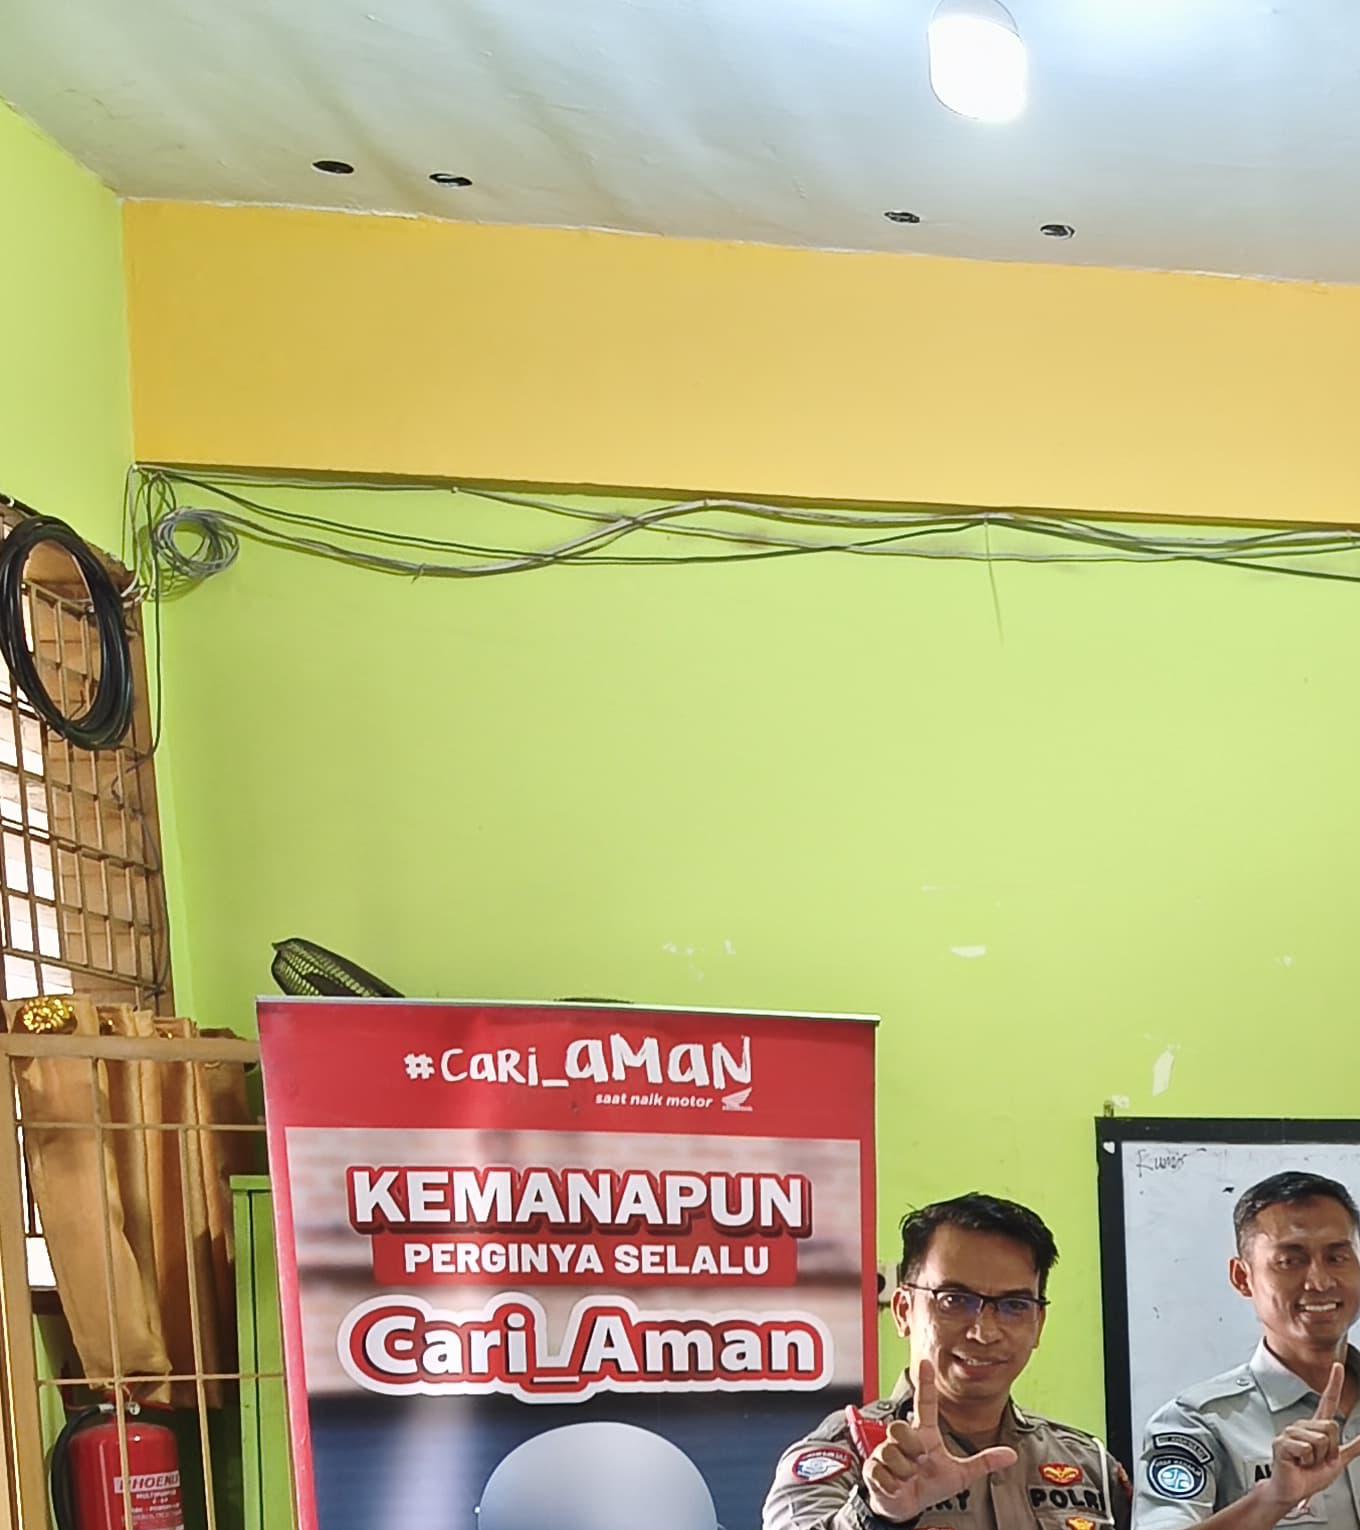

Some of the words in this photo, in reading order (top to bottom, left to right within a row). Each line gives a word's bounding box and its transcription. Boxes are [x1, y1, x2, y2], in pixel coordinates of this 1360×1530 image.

[595, 1093, 627, 1106] saat
[630, 1092, 662, 1106] naik
[666, 1094, 713, 1107] motor
[353, 1170, 804, 1228] KEMANAPUN
[404, 1242, 603, 1274] PERGINYA
[614, 1243, 769, 1275] SELALU
[365, 1312, 815, 1385] Cari_Aman
[1030, 1488, 1106, 1511] POLRI
